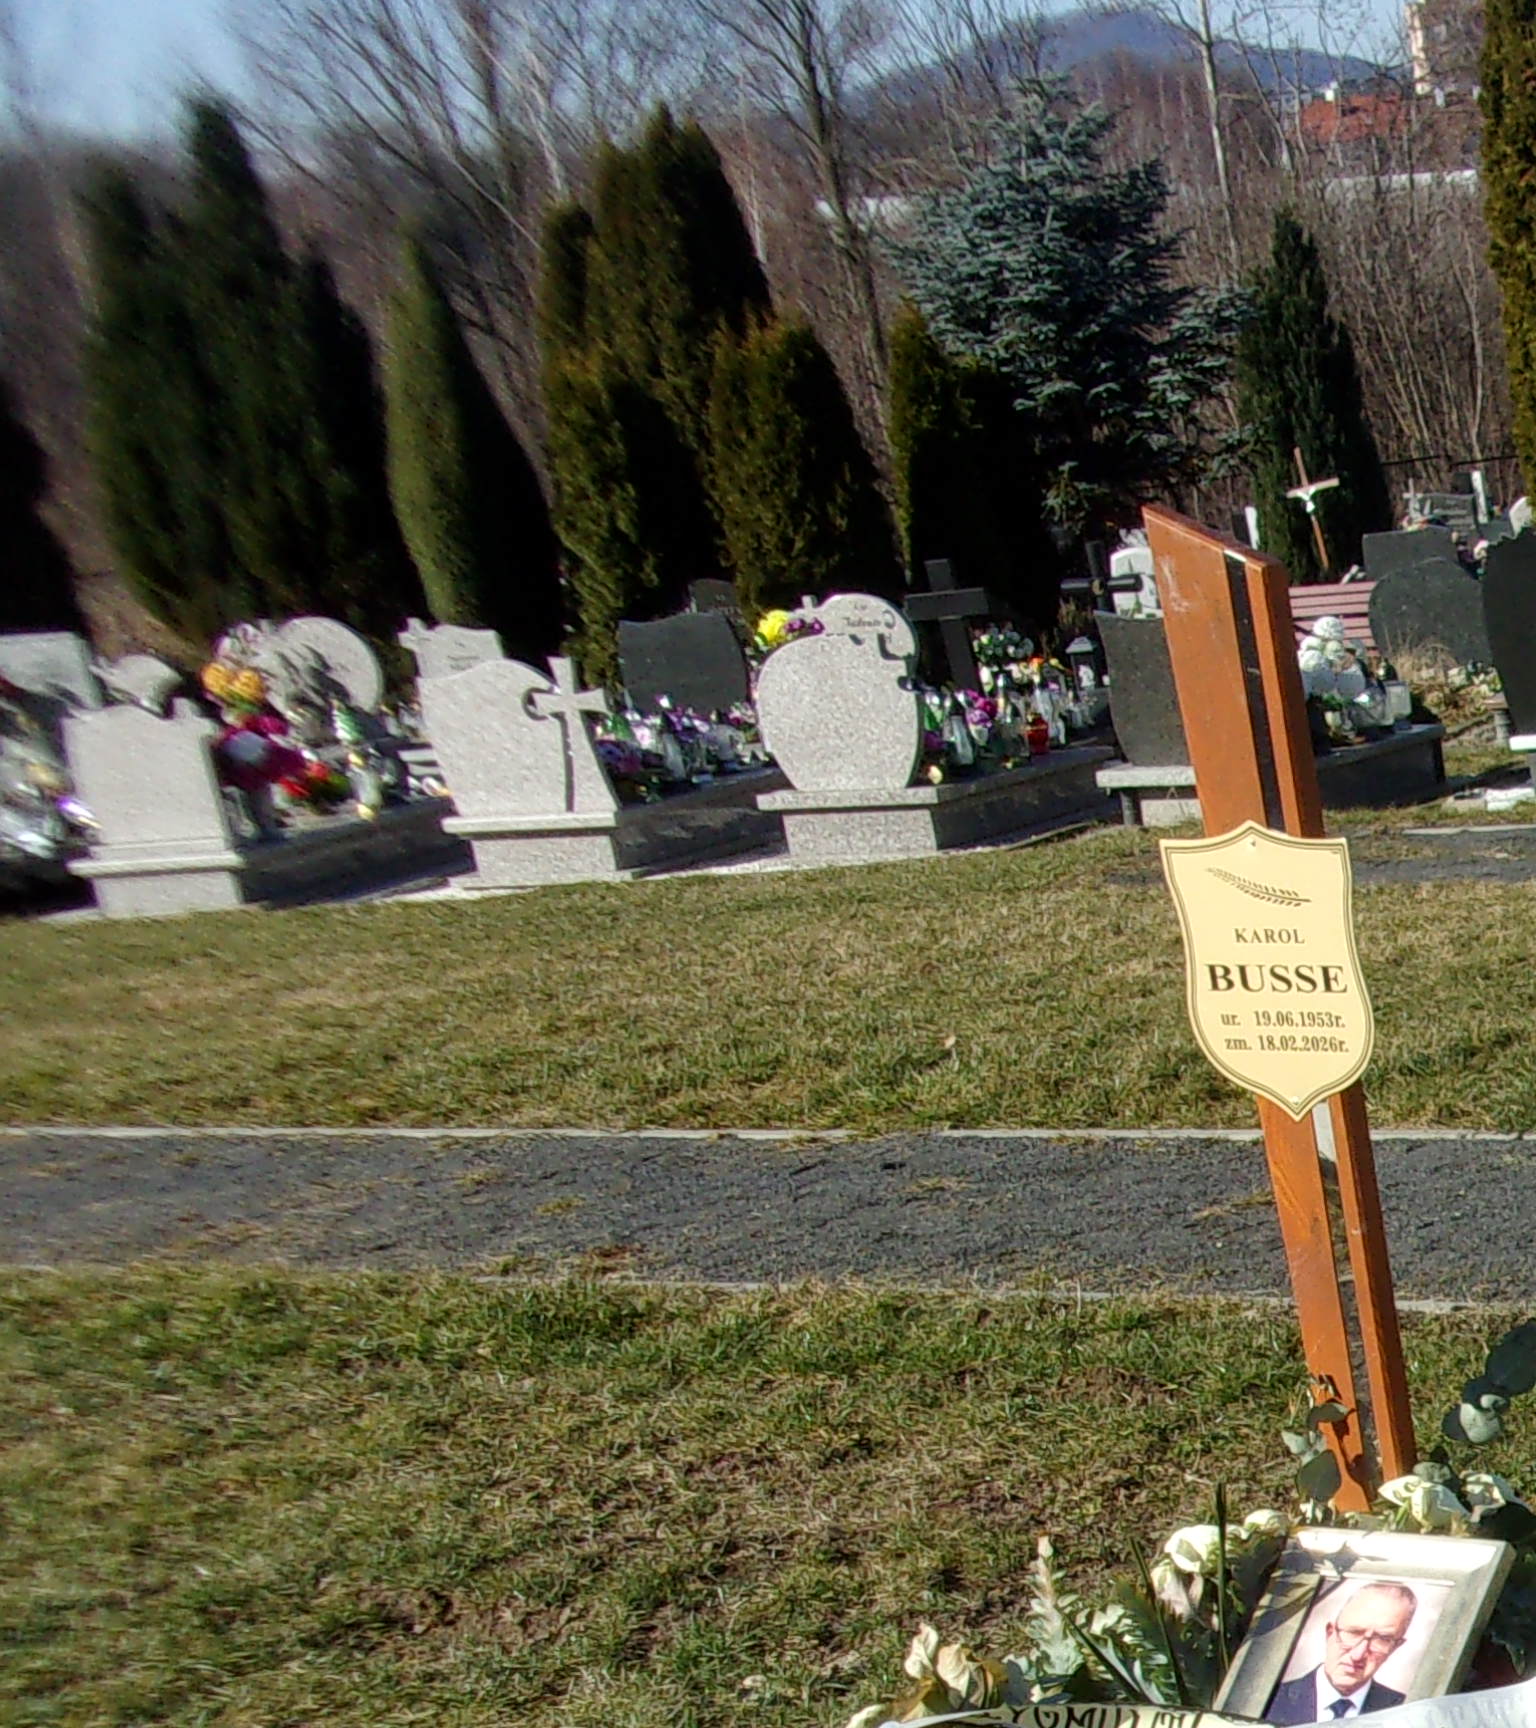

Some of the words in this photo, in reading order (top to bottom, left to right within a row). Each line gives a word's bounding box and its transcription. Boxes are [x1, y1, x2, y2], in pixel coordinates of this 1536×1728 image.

[1234, 927, 1306, 945] KAROL
[1204, 963, 1349, 994] BUSSE
[1220, 1011, 1242, 1027] ur.
[1253, 1009, 1347, 1029] 19.06.1953r.
[1224, 1036, 1253, 1052] zm.
[1258, 1033, 1351, 1054] 18.02.2026r.
